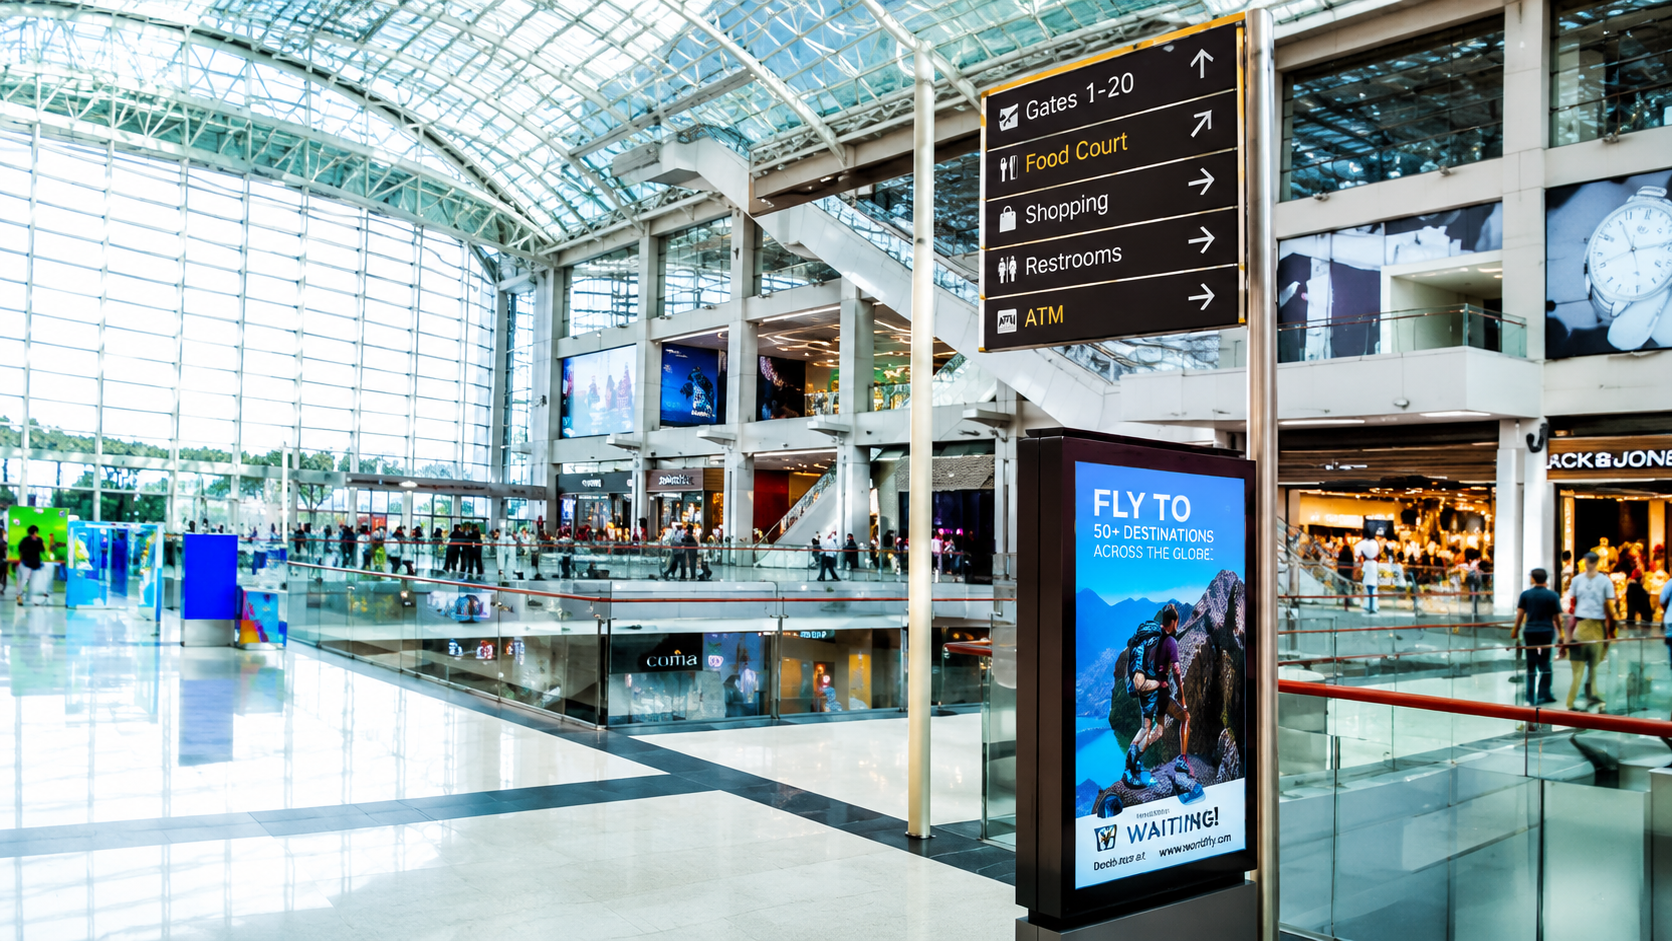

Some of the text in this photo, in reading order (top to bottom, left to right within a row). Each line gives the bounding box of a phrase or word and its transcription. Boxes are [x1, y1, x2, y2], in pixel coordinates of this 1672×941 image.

[1026, 72, 1134, 120] Gates 1-20
[1026, 132, 1128, 172] Food Court
[1025, 193, 1108, 224] Shopping
[1026, 246, 1122, 275] Restrooms
[1025, 305, 1064, 327] ATM
[1094, 489, 1191, 522] FLY TO
[1094, 524, 1214, 543] 50+ DESTINATIONS
[1094, 544, 1143, 559] ACROSS
[1147, 546, 1170, 560] THE
